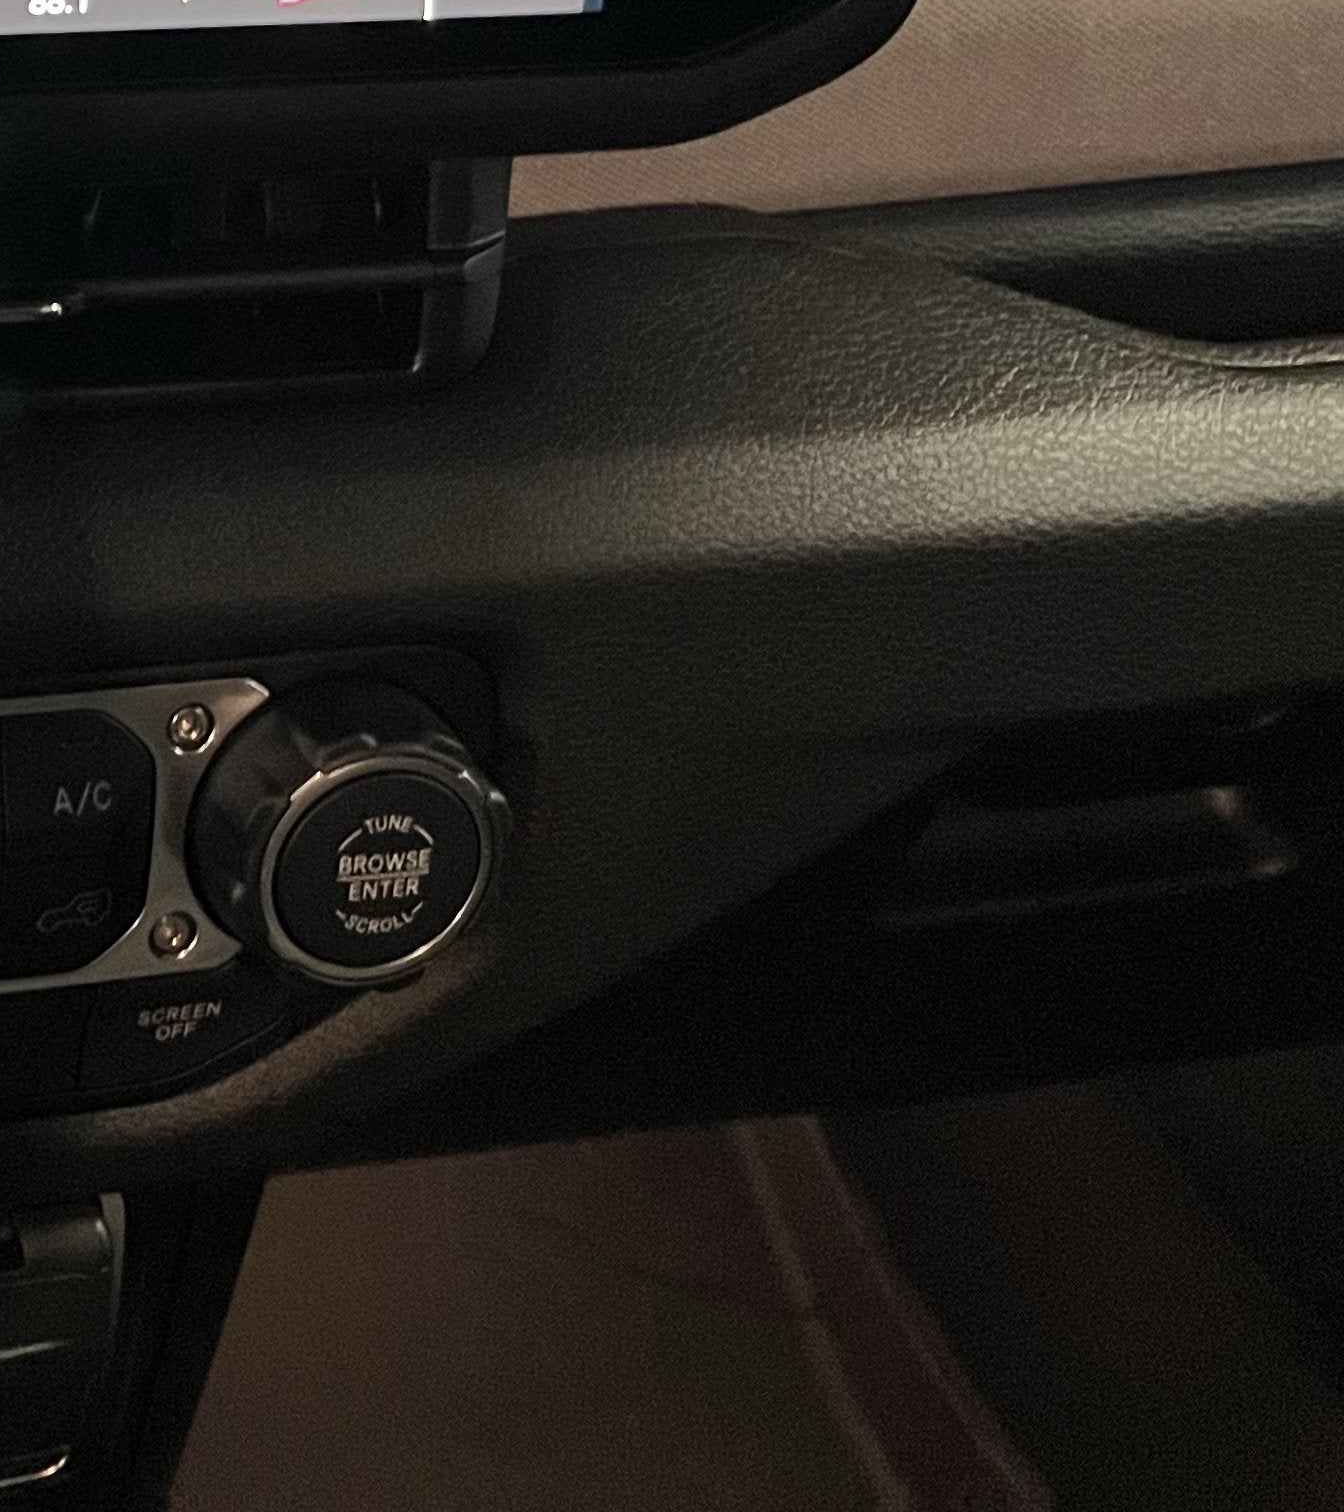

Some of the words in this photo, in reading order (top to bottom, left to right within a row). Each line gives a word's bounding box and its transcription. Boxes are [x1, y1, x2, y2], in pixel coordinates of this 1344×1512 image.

[53, 782, 112, 816] A/C
[363, 814, 414, 835] TUNE
[338, 848, 431, 875] BROWSE
[348, 878, 419, 901] ENTER
[343, 911, 415, 935] SCROLL
[137, 1002, 222, 1028] SCREEN
[154, 1018, 198, 1041] OFF
